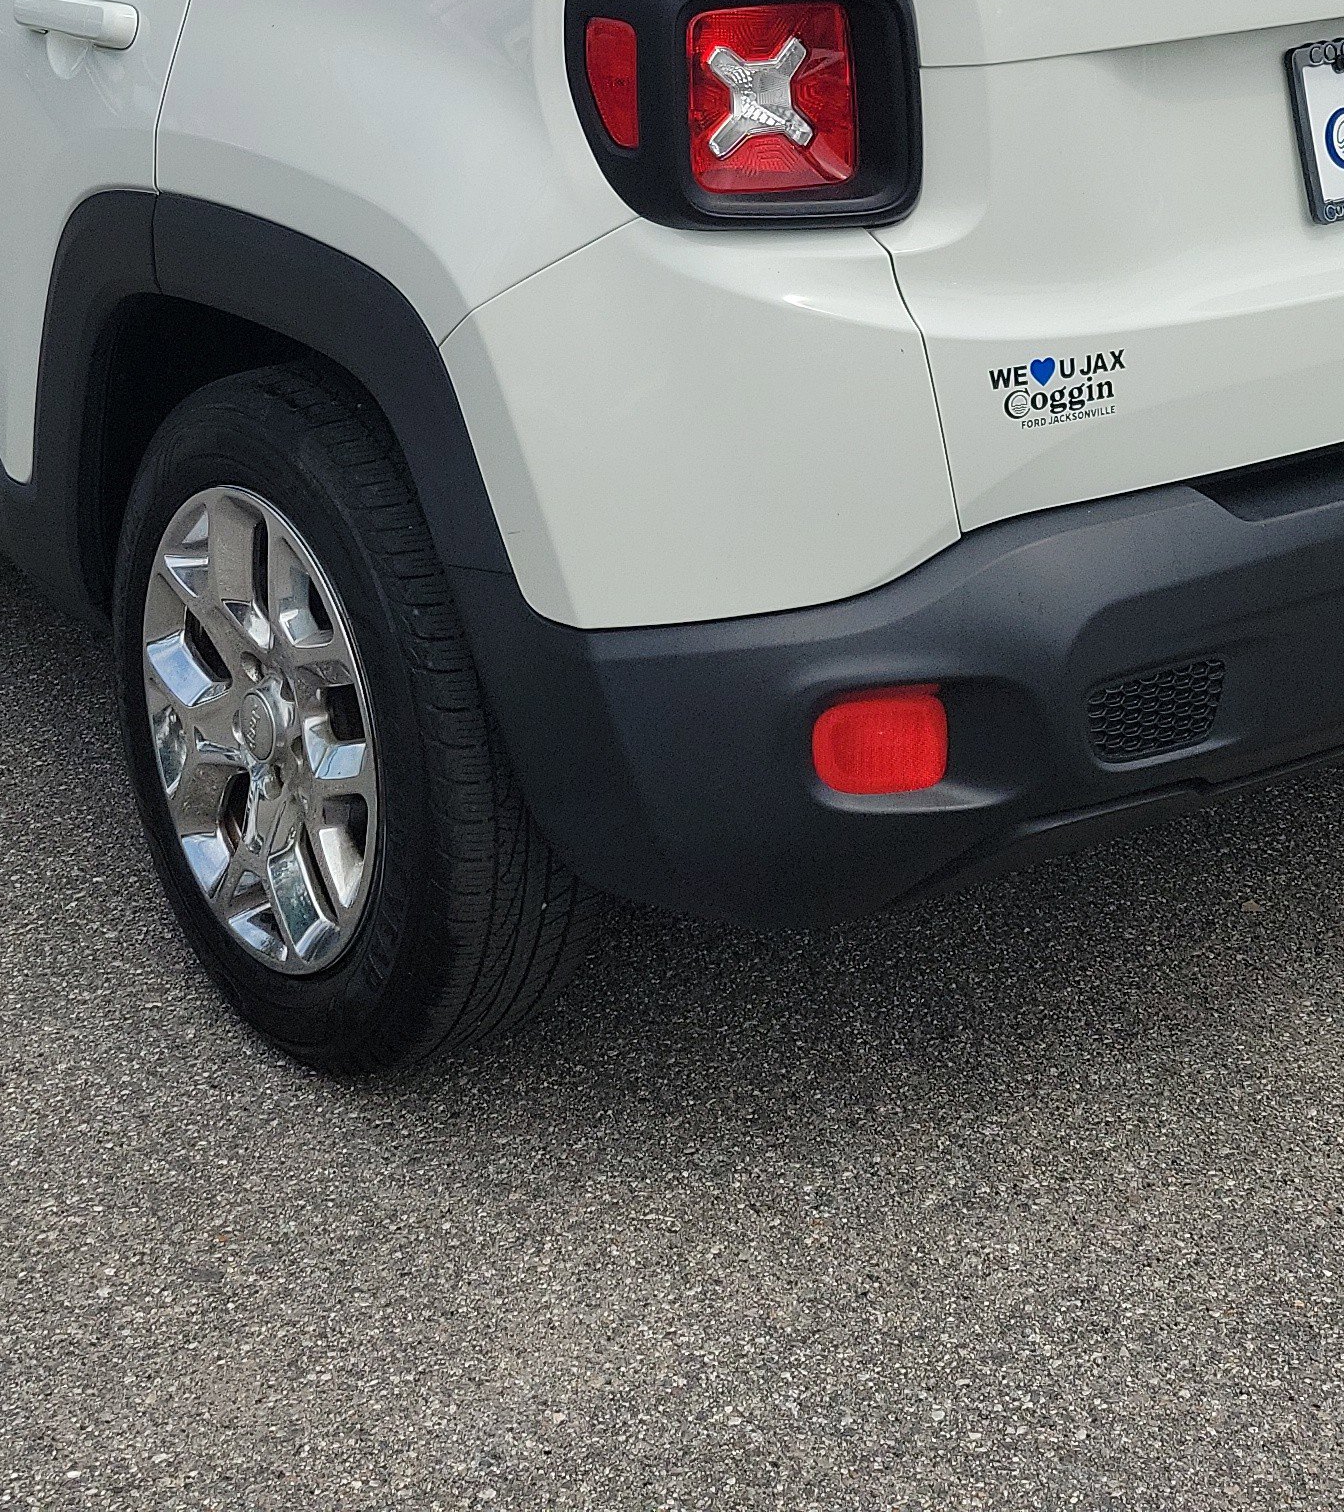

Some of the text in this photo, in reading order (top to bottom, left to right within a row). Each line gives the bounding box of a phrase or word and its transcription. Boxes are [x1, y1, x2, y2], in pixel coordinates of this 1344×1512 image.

[989, 349, 1126, 390] WE U JAX
[1003, 376, 1115, 419] Coggin
[1021, 405, 1116, 429] FORD JACKSONVILLE
